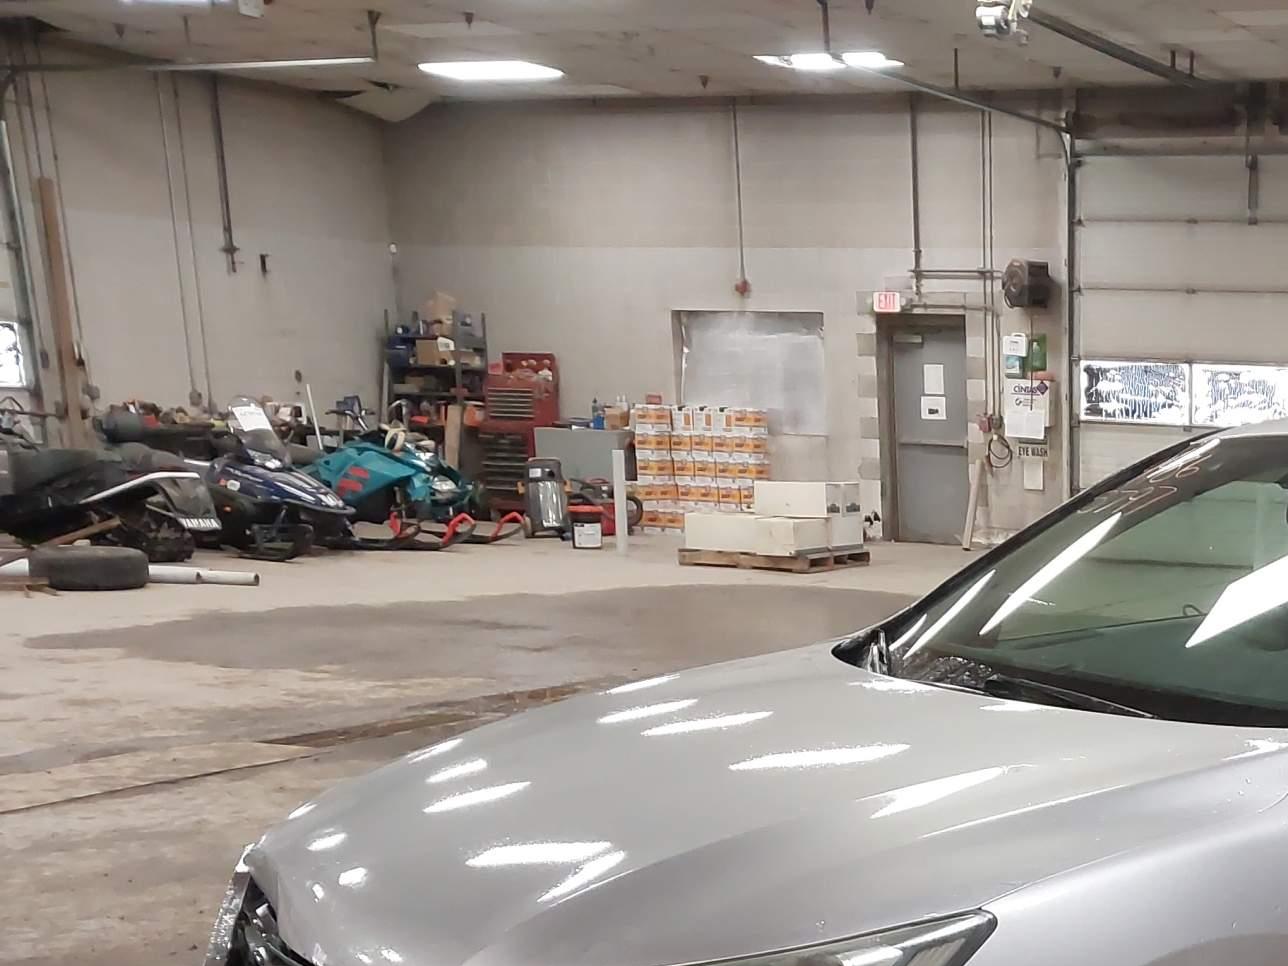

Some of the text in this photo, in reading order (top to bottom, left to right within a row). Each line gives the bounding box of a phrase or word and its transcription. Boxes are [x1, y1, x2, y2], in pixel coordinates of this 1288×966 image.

[878, 293, 897, 310] EXIT
[1018, 446, 1049, 458] EYE WASH
[180, 517, 220, 529] YAMAHA
